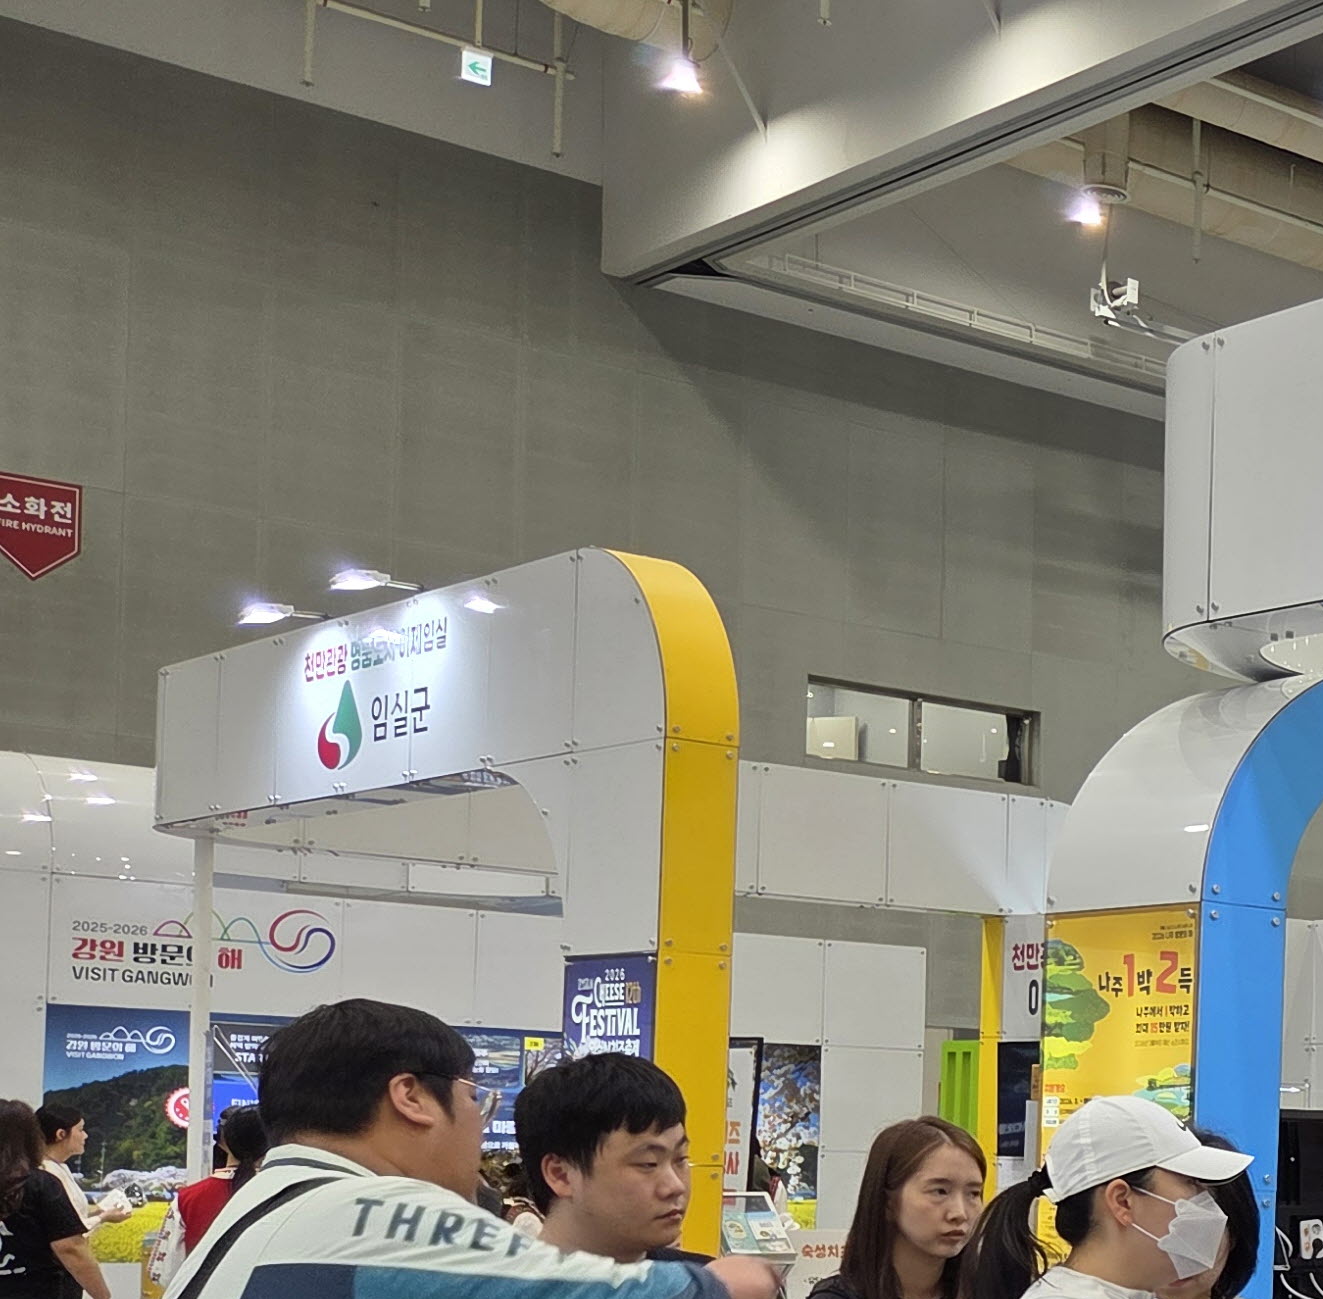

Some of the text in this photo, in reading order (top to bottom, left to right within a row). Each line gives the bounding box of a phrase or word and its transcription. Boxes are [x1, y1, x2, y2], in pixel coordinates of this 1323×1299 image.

[0, 493, 72, 523] 소화전
[22, 521, 73, 538] HYDRANT
[304, 643, 348, 683] 천만관광
[371, 686, 430, 742] 임실군
[72, 920, 148, 936] 2025-2026
[71, 937, 125, 963] 강원
[218, 947, 242, 970] 해
[72, 966, 213, 987] VISIT GANGW
[604, 968, 626, 981] 2026
[594, 977, 626, 1008] CHEESE
